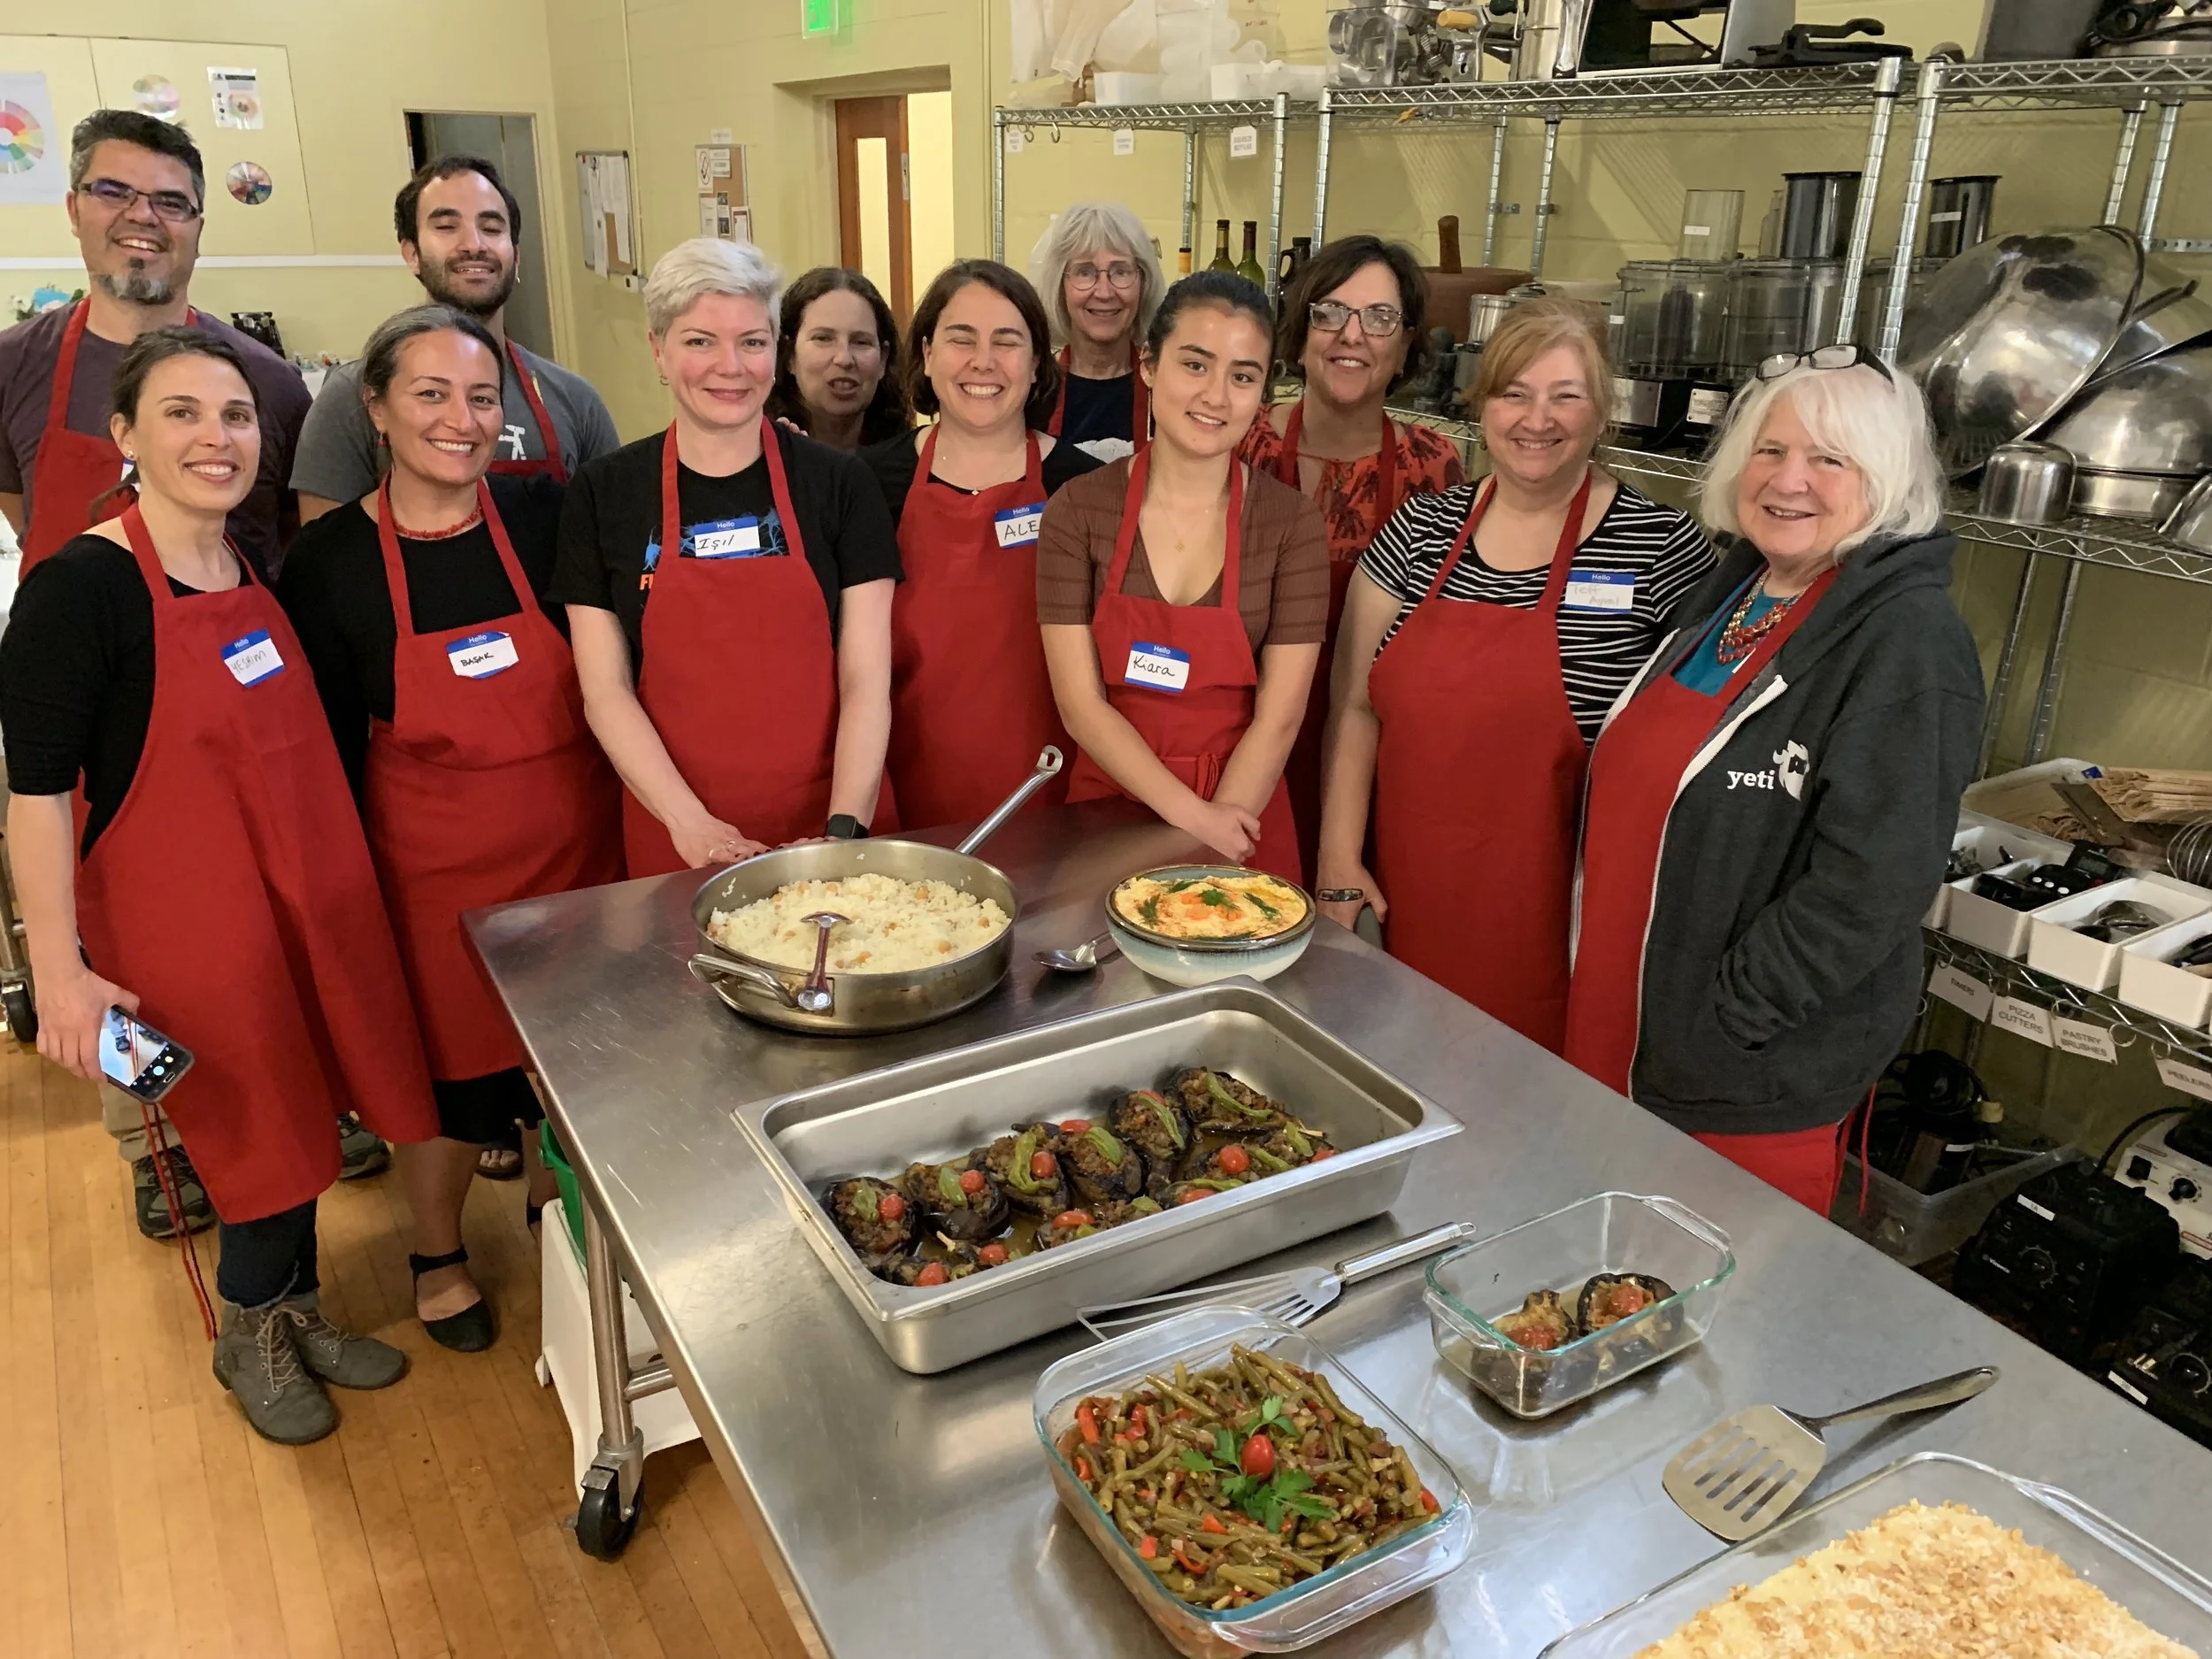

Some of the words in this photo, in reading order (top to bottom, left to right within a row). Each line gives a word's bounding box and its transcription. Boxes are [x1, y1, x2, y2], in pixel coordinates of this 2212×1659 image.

[234, 638, 250, 649] Hello
[468, 634, 488, 644] Hello
[1153, 645, 1171, 655] Hello
[1133, 655, 1176, 677] Kiara
[1726, 769, 1776, 790] yeti
[2008, 1004, 2036, 1021] PIZZA
[1998, 1011, 2044, 1034] CUTTERS
[2062, 1029, 2102, 1044] PASTRY
[2060, 1037, 2108, 1056] BRUSHES
